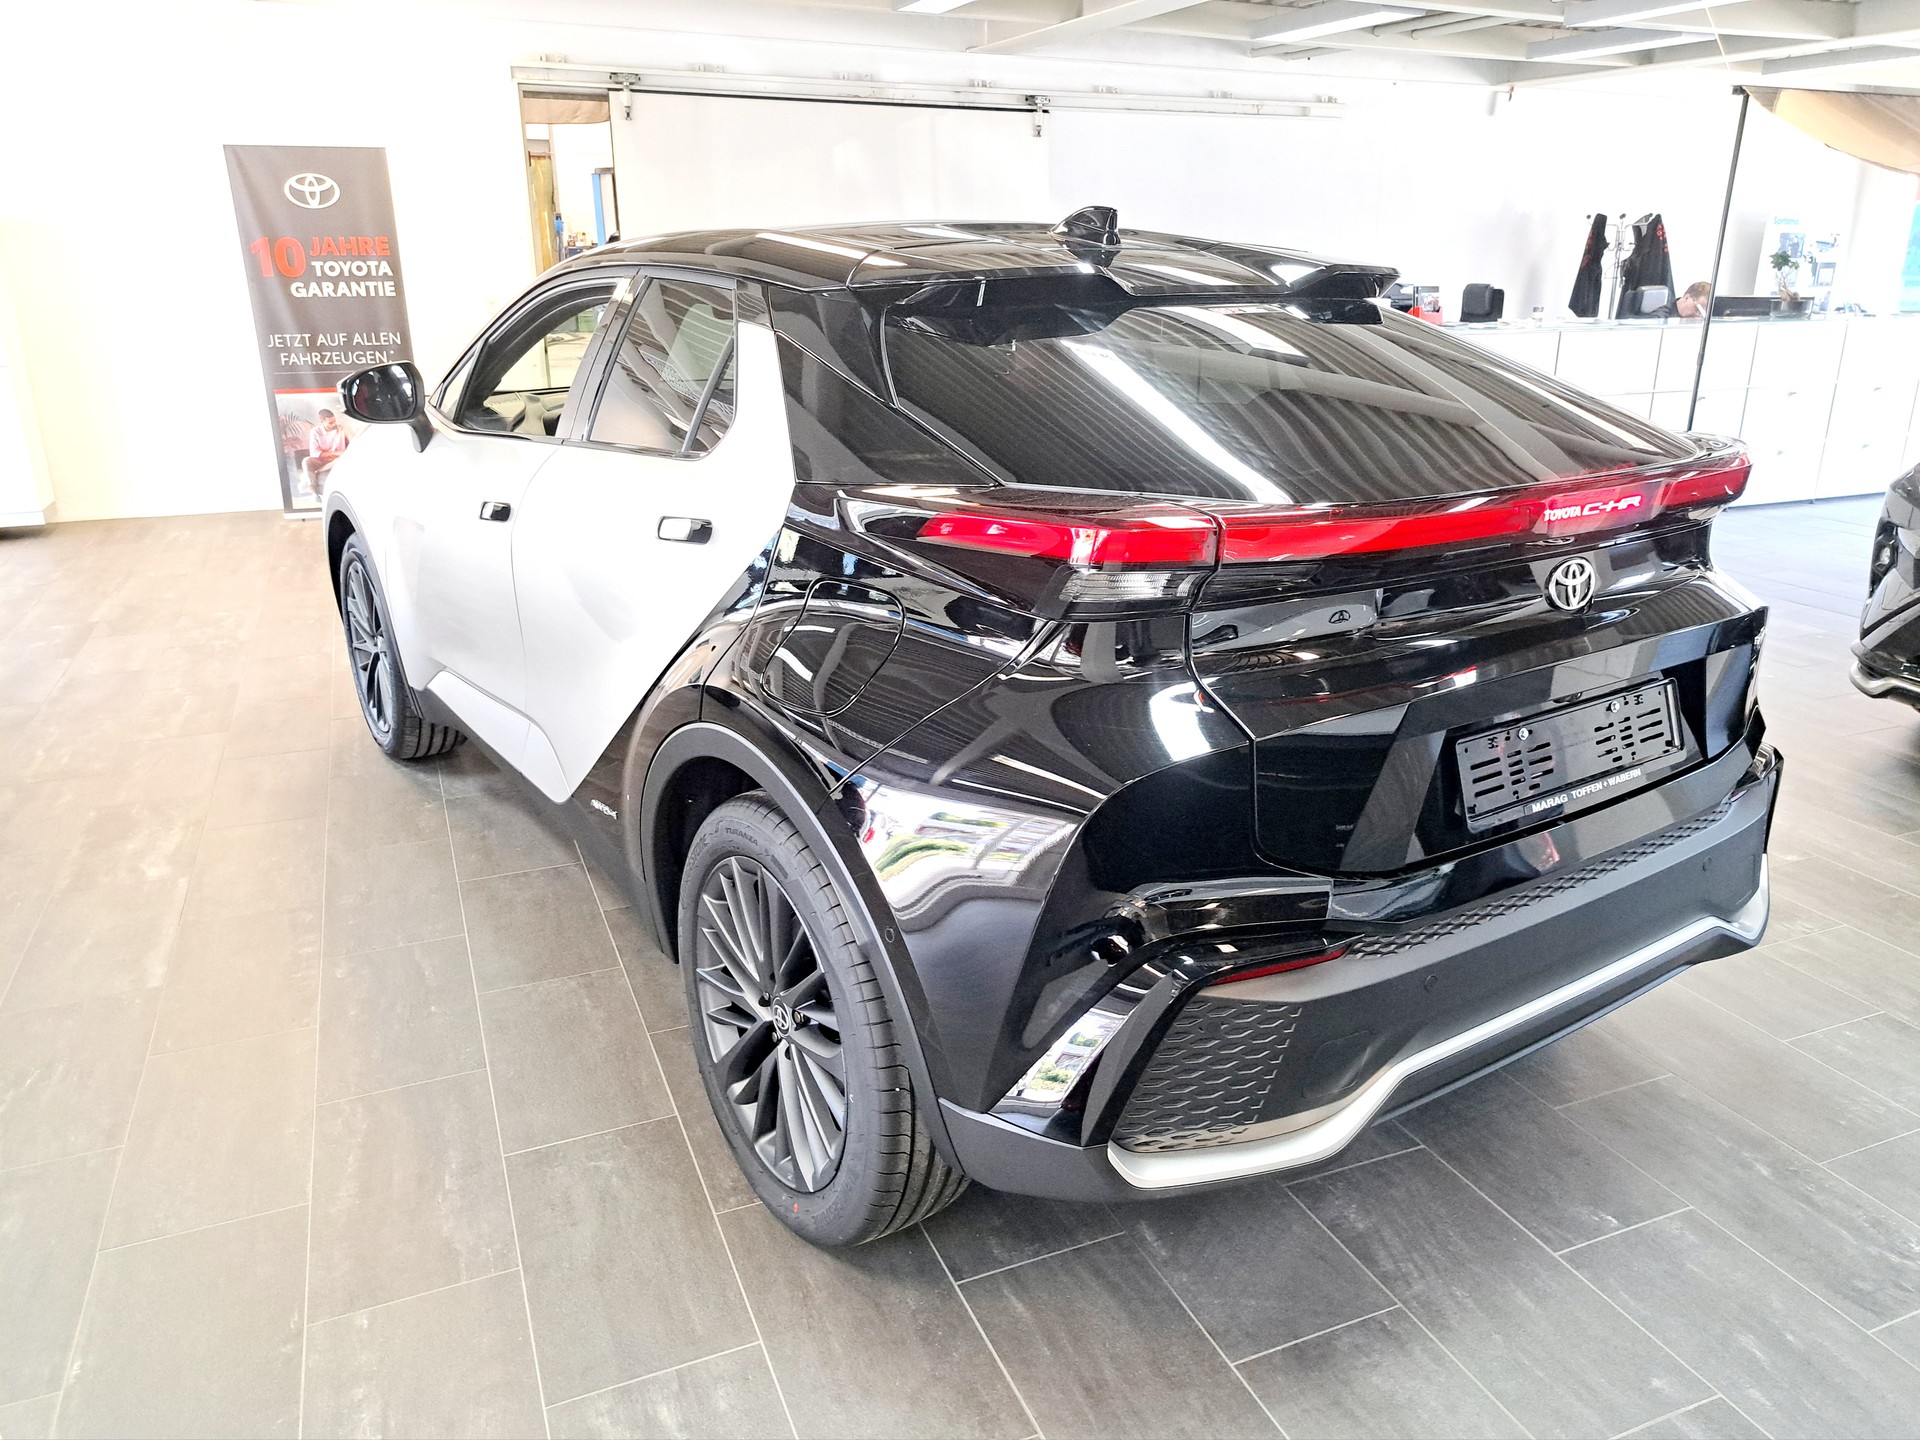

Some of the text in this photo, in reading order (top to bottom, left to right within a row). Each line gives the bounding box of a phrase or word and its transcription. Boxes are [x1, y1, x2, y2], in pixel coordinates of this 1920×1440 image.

[250, 236, 391, 278] 10 JAHRE
[311, 260, 394, 277] TOYOTA
[290, 281, 397, 298] GARANTIE
[268, 332, 402, 348] JETZT AUF ALLEN
[1543, 505, 1581, 522] TOYOTA
[1531, 794, 1569, 813] MARAG
[1571, 780, 1603, 800] TOFFEN
[1607, 768, 1642, 787] WABERN
